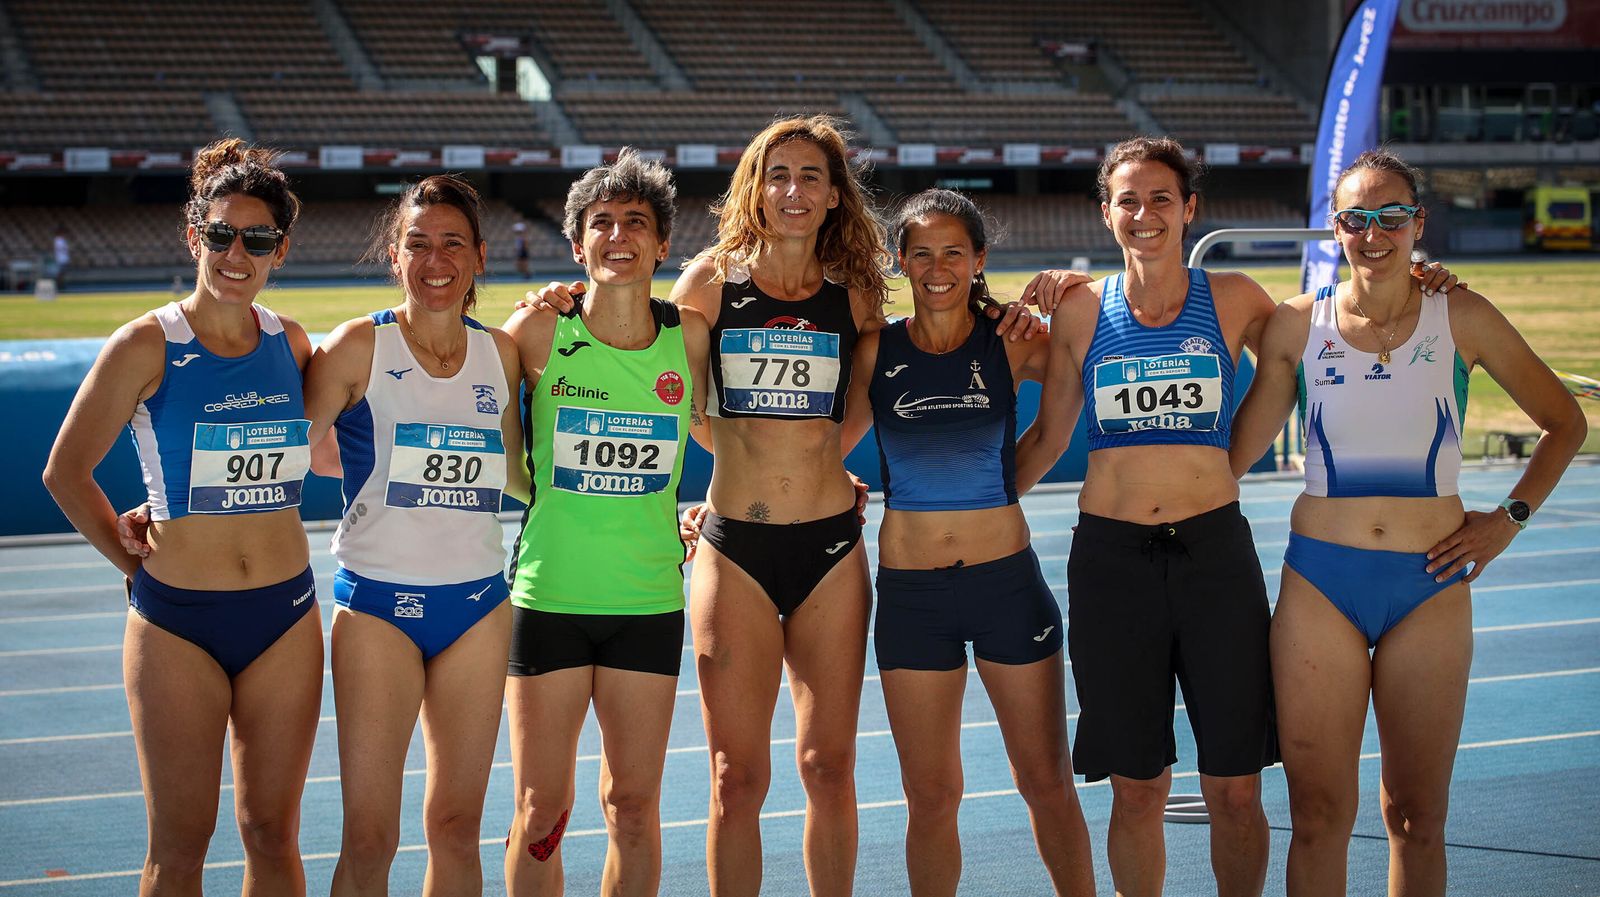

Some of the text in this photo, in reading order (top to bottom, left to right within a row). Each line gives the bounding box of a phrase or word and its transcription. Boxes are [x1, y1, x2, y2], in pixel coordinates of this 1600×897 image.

[1411, 0, 1555, 26] Cruzcampo
[769, 333, 813, 344] LOTERÍAS
[1180, 337, 1211, 349] PRATENC
[750, 358, 810, 387] 778
[1144, 358, 1190, 369] LOTERÍAS
[1314, 378, 1335, 386] Suma
[225, 391, 257, 401] CLUB
[551, 384, 609, 400] BiClinic
[748, 391, 809, 409] Joma
[1114, 383, 1203, 414] 1043
[246, 424, 287, 436] LOTERÍAS
[608, 416, 654, 427] LOTERÍAS
[448, 430, 486, 440] LOTERÍAS
[573, 440, 660, 470] 1092
[226, 452, 284, 483] 907
[423, 453, 482, 484] 830
[577, 472, 645, 492] Joma
[222, 486, 286, 508] Joma
[417, 488, 479, 506] Joma
